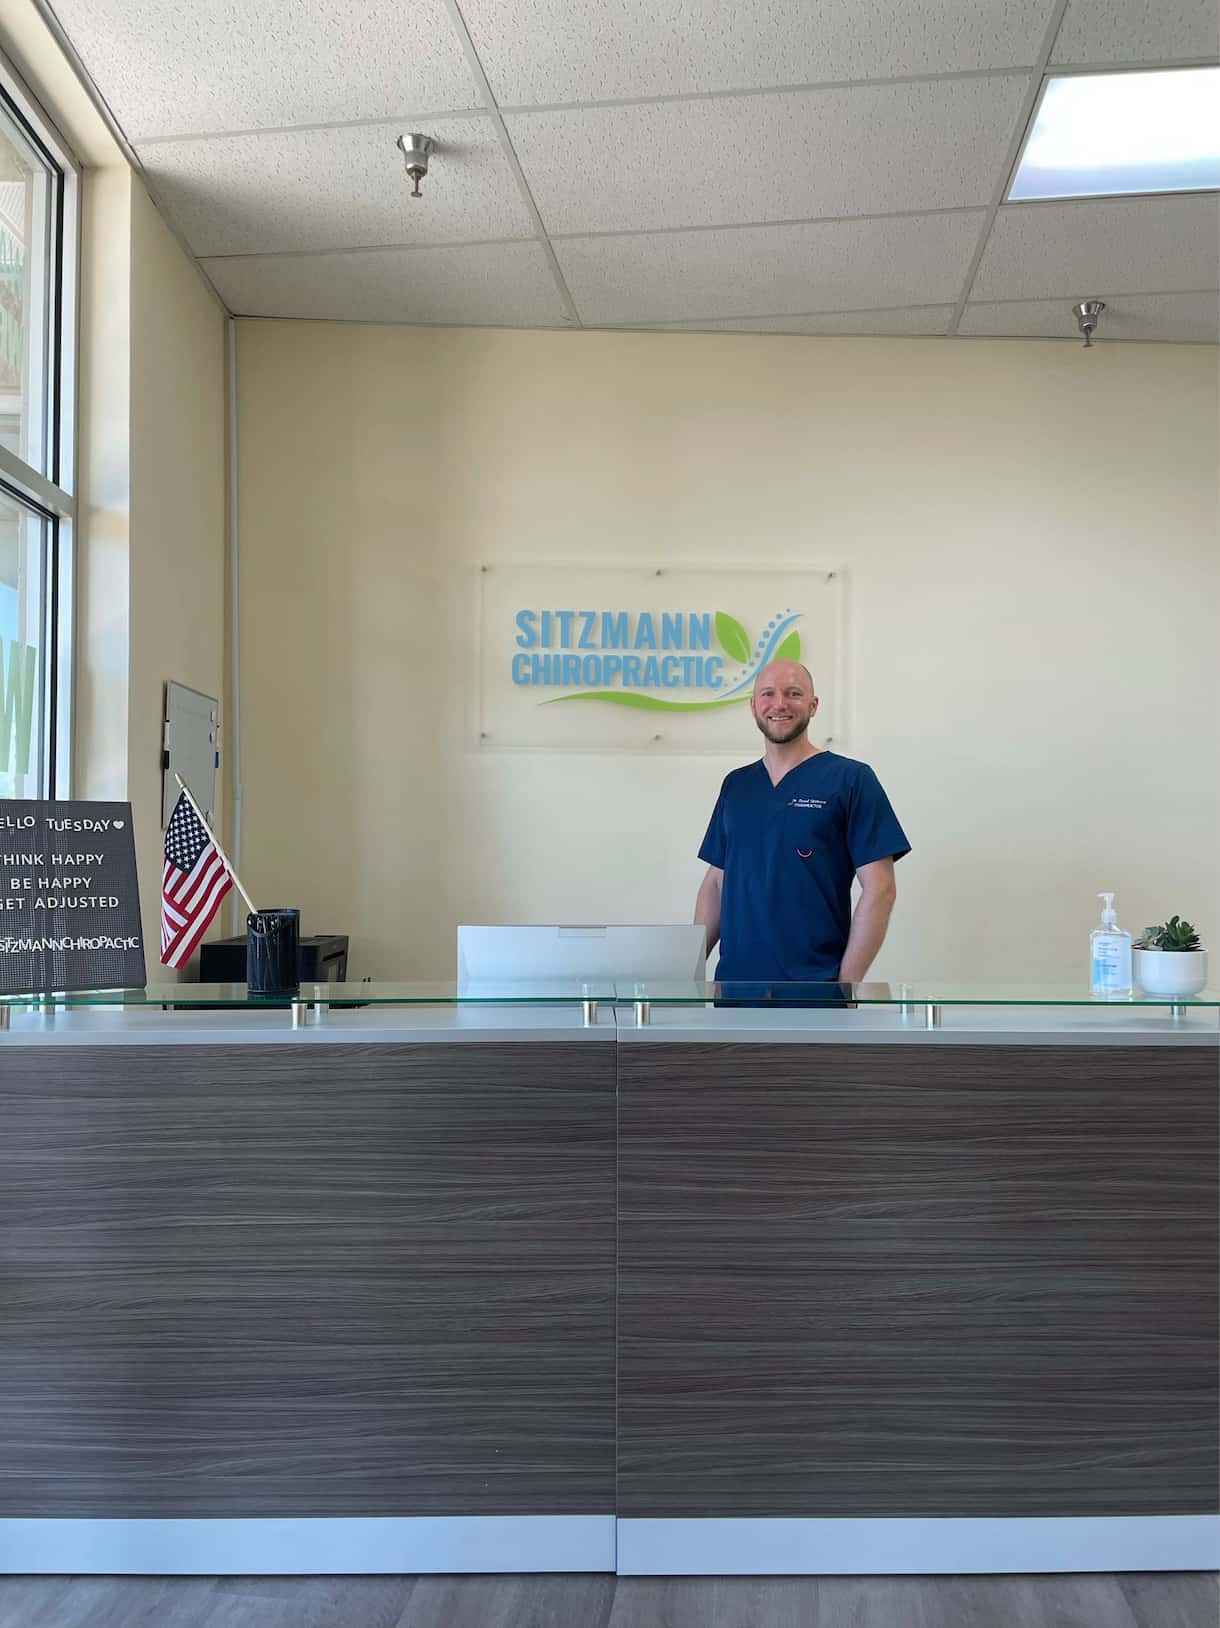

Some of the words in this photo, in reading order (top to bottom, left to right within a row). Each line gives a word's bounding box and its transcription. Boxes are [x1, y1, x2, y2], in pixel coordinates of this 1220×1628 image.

[515, 609, 710, 650] SITZMANN
[512, 653, 723, 688] CHIROPRACTIC
[46, 817, 110, 832] TUESDAY
[0, 854, 44, 865] HINK
[51, 853, 104, 865] HAPPY
[10, 878, 31, 889] BE
[38, 877, 91, 889] HAPPY
[34, 896, 119, 909] ADJUSTED
